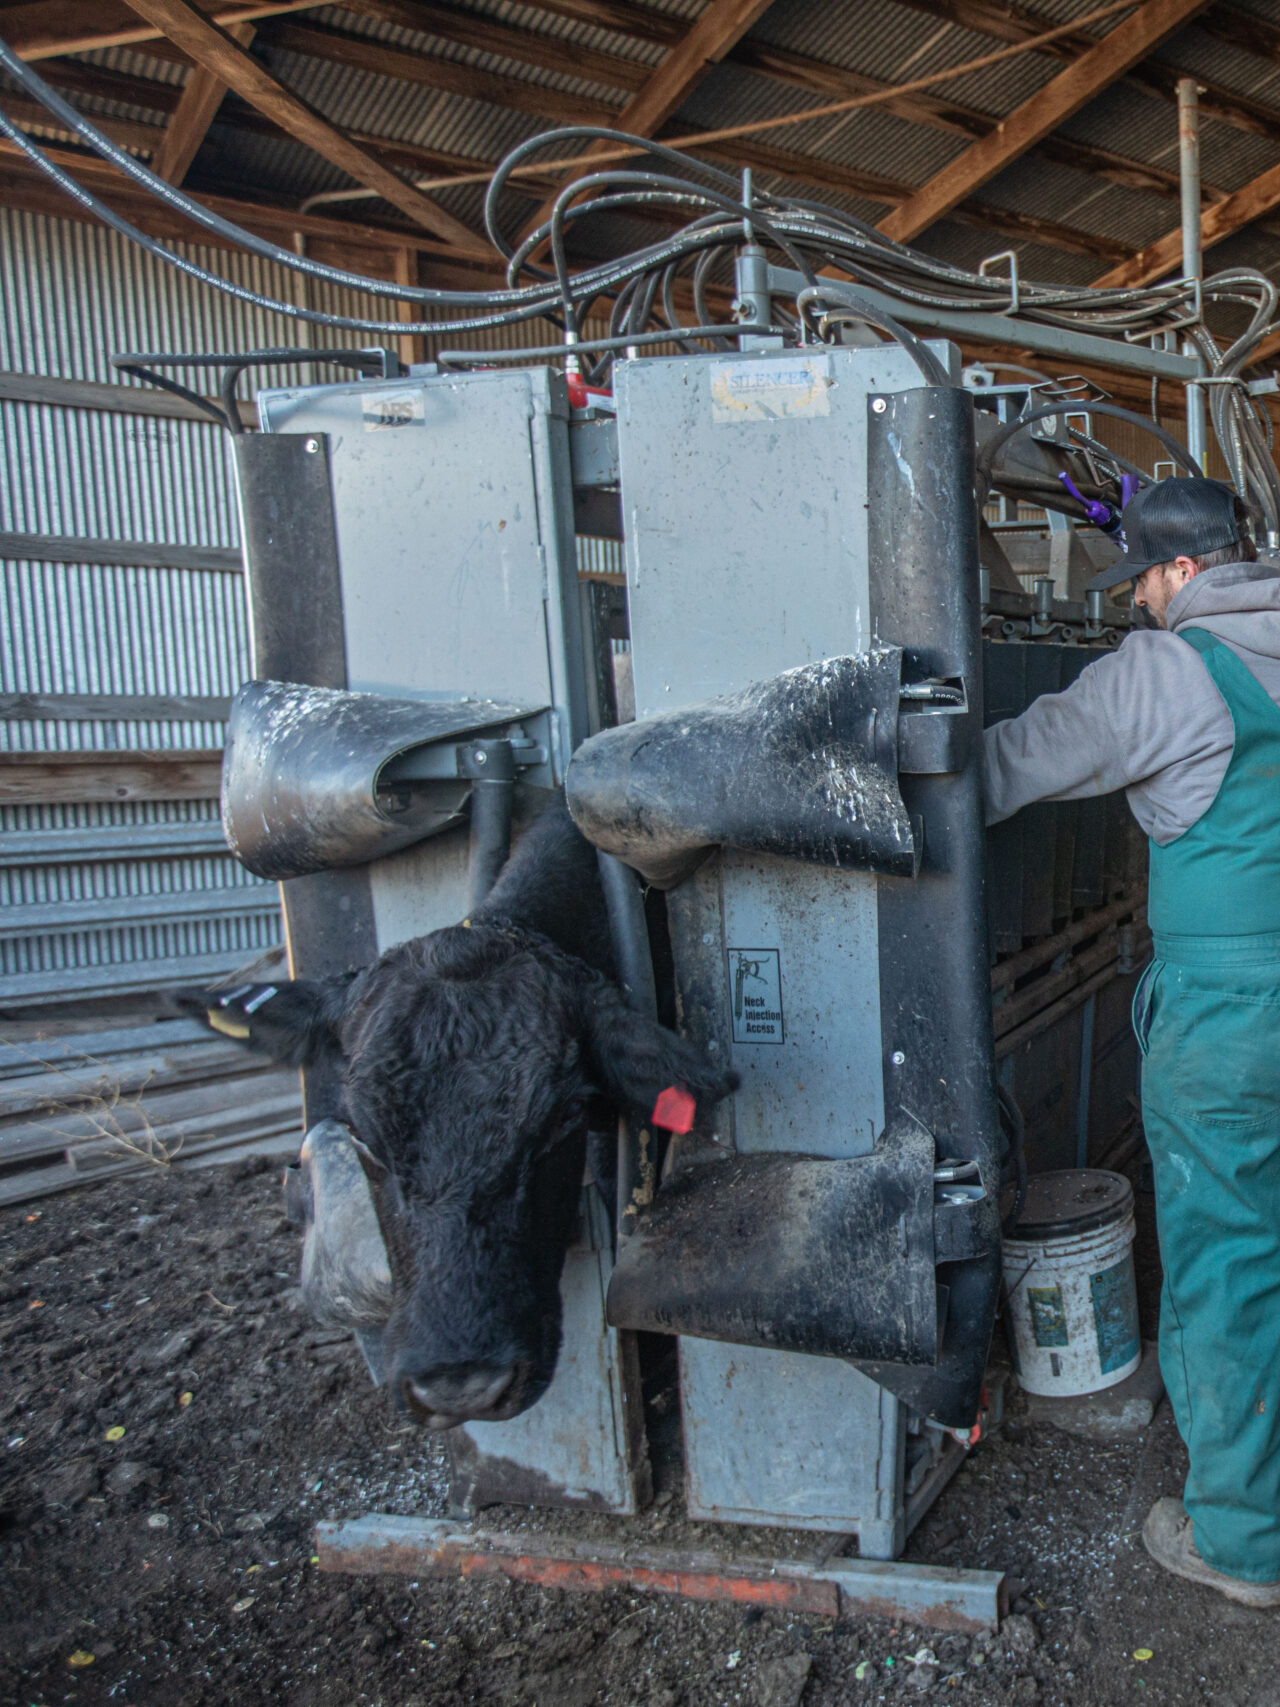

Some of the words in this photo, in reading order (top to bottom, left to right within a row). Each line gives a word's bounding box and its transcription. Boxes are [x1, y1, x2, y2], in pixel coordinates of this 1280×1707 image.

[152, 181, 166, 193] WP
[163, 189, 193, 211] Q1/2019
[744, 996, 766, 1008] Neck
[745, 1010, 781, 1021] Injection
[746, 1022, 776, 1034] Access
